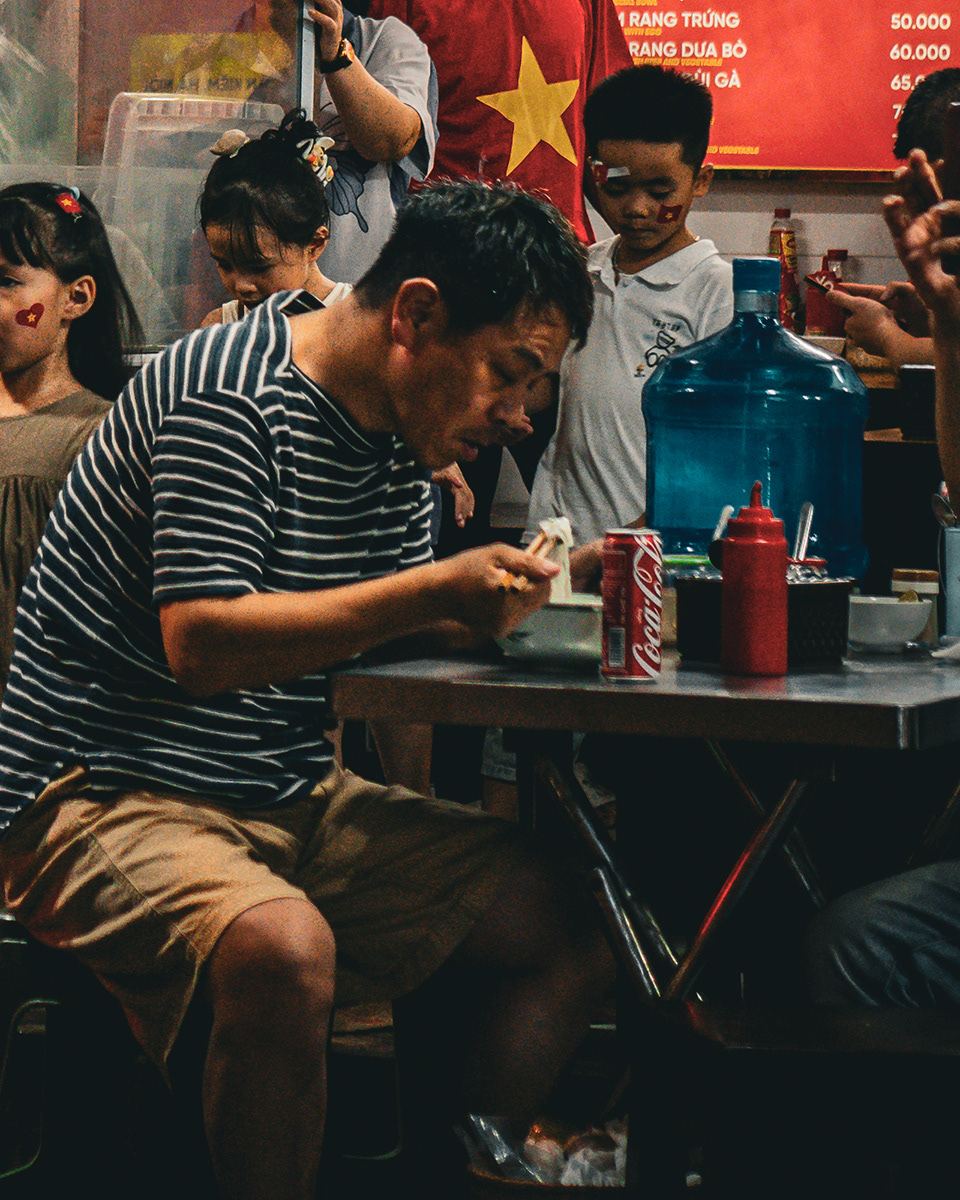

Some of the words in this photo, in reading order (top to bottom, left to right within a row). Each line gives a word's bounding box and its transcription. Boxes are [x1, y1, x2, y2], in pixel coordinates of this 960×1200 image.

[629, 12, 677, 28] RANG
[681, 8, 740, 28] TRỨNG
[890, 13, 951, 30] 50.000
[629, 41, 677, 58] RANG
[681, 41, 717, 58] DƯA
[722, 38, 747, 58] BÒ
[889, 43, 951, 61] 60.000
[715, 68, 741, 88] GÀ
